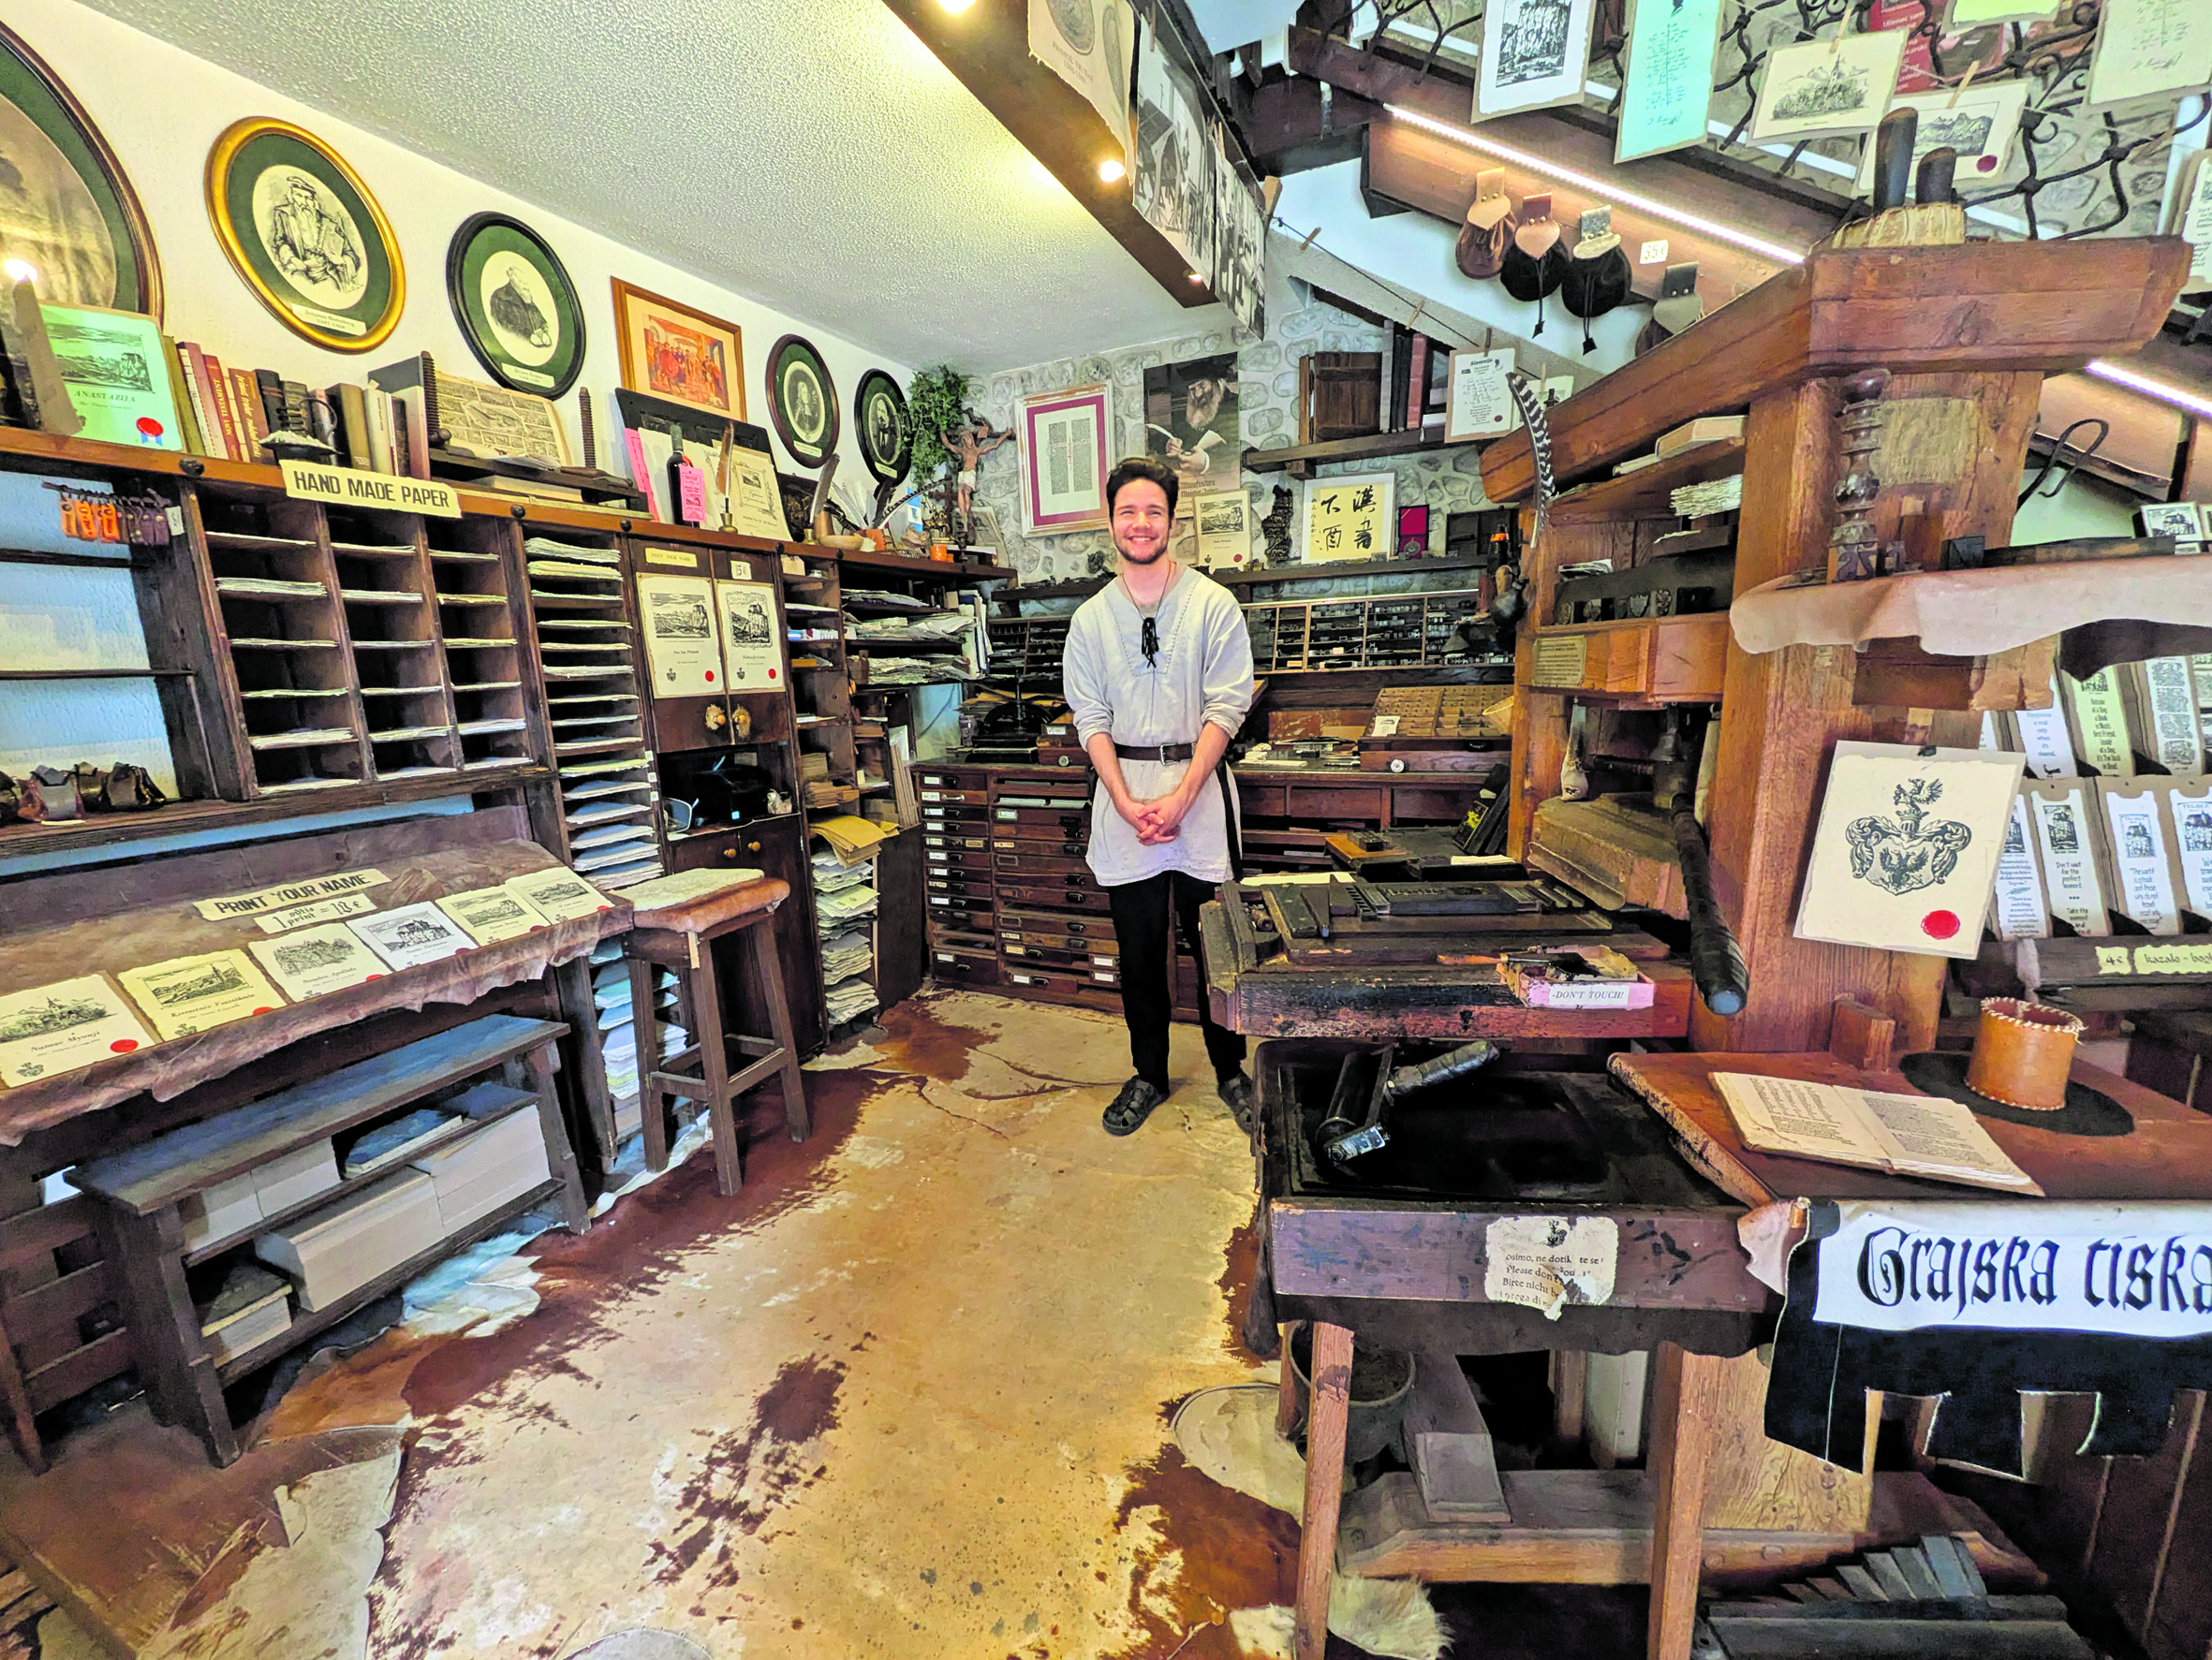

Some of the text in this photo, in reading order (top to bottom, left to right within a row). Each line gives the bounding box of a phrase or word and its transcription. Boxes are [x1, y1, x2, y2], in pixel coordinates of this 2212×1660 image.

[74, 389, 136, 403] ANASTAZIJA
[214, 378, 228, 418] TESTAMENT
[294, 470, 450, 508] HAND MADE PAPER
[214, 874, 371, 914] PRINT YOUR NAME
[288, 906, 316, 918] odtis
[287, 912, 317, 928] print
[1588, 991, 1625, 999] TOUCH!
[1506, 1254, 1534, 1262] osimo,
[1506, 1265, 1533, 1275] Please
[1856, 1227, 2212, 1320] Grajska tiska
[1502, 1277, 1526, 1287] Bitte
[1526, 1281, 1549, 1294] nicht
[1532, 1296, 1541, 1305] di
